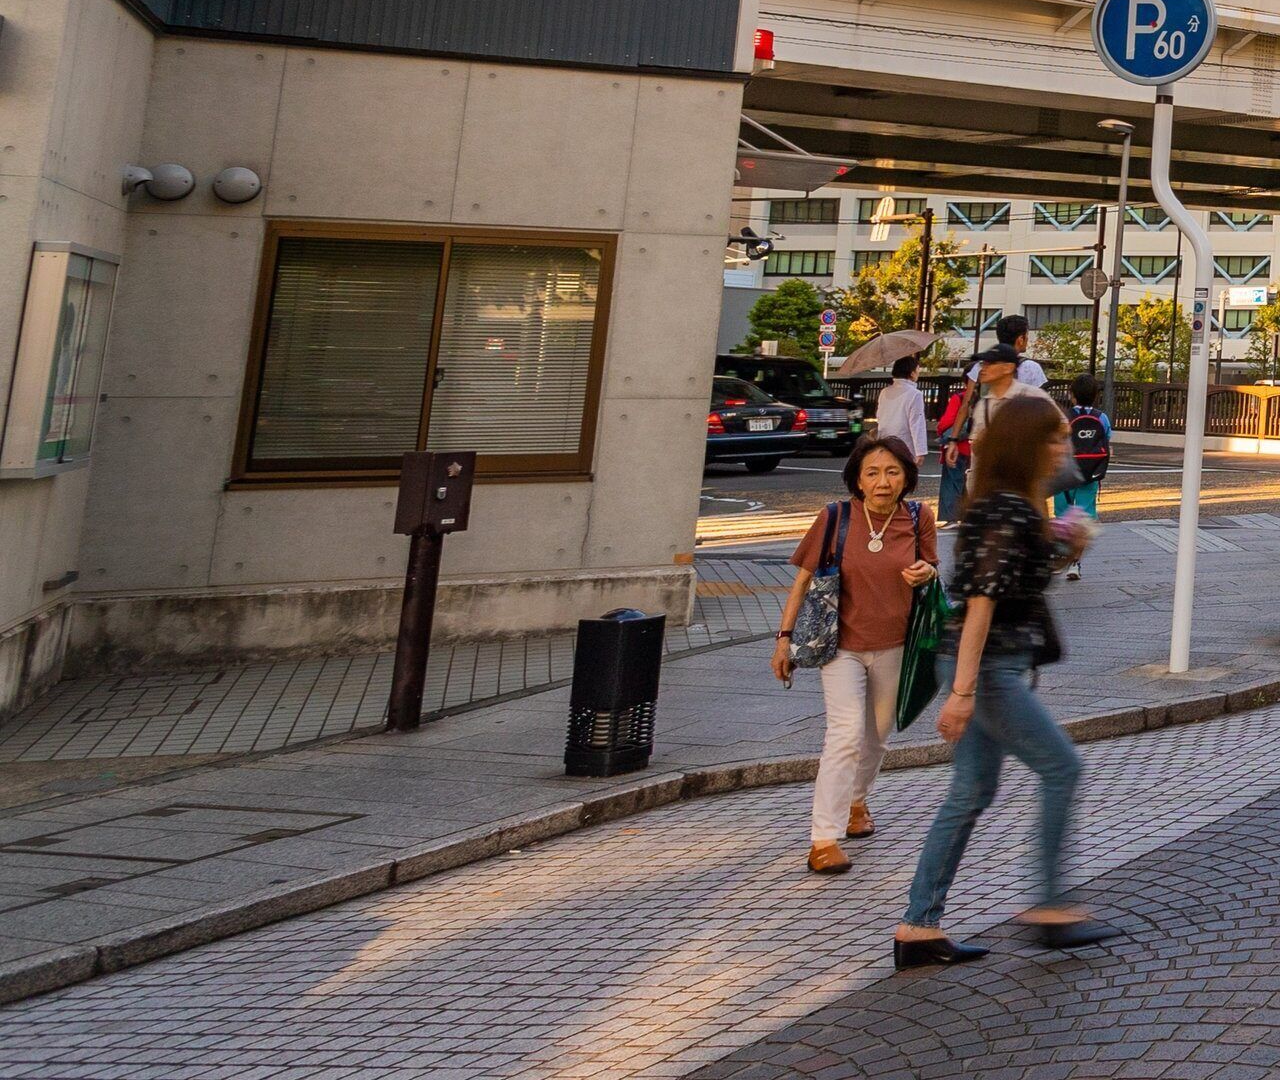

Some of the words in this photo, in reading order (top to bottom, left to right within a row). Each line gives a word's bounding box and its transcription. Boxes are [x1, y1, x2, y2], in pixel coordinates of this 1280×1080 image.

[1187, 14, 1200, 33] 分
[1153, 30, 1186, 60] 60
[1078, 429, 1097, 439] CR7
